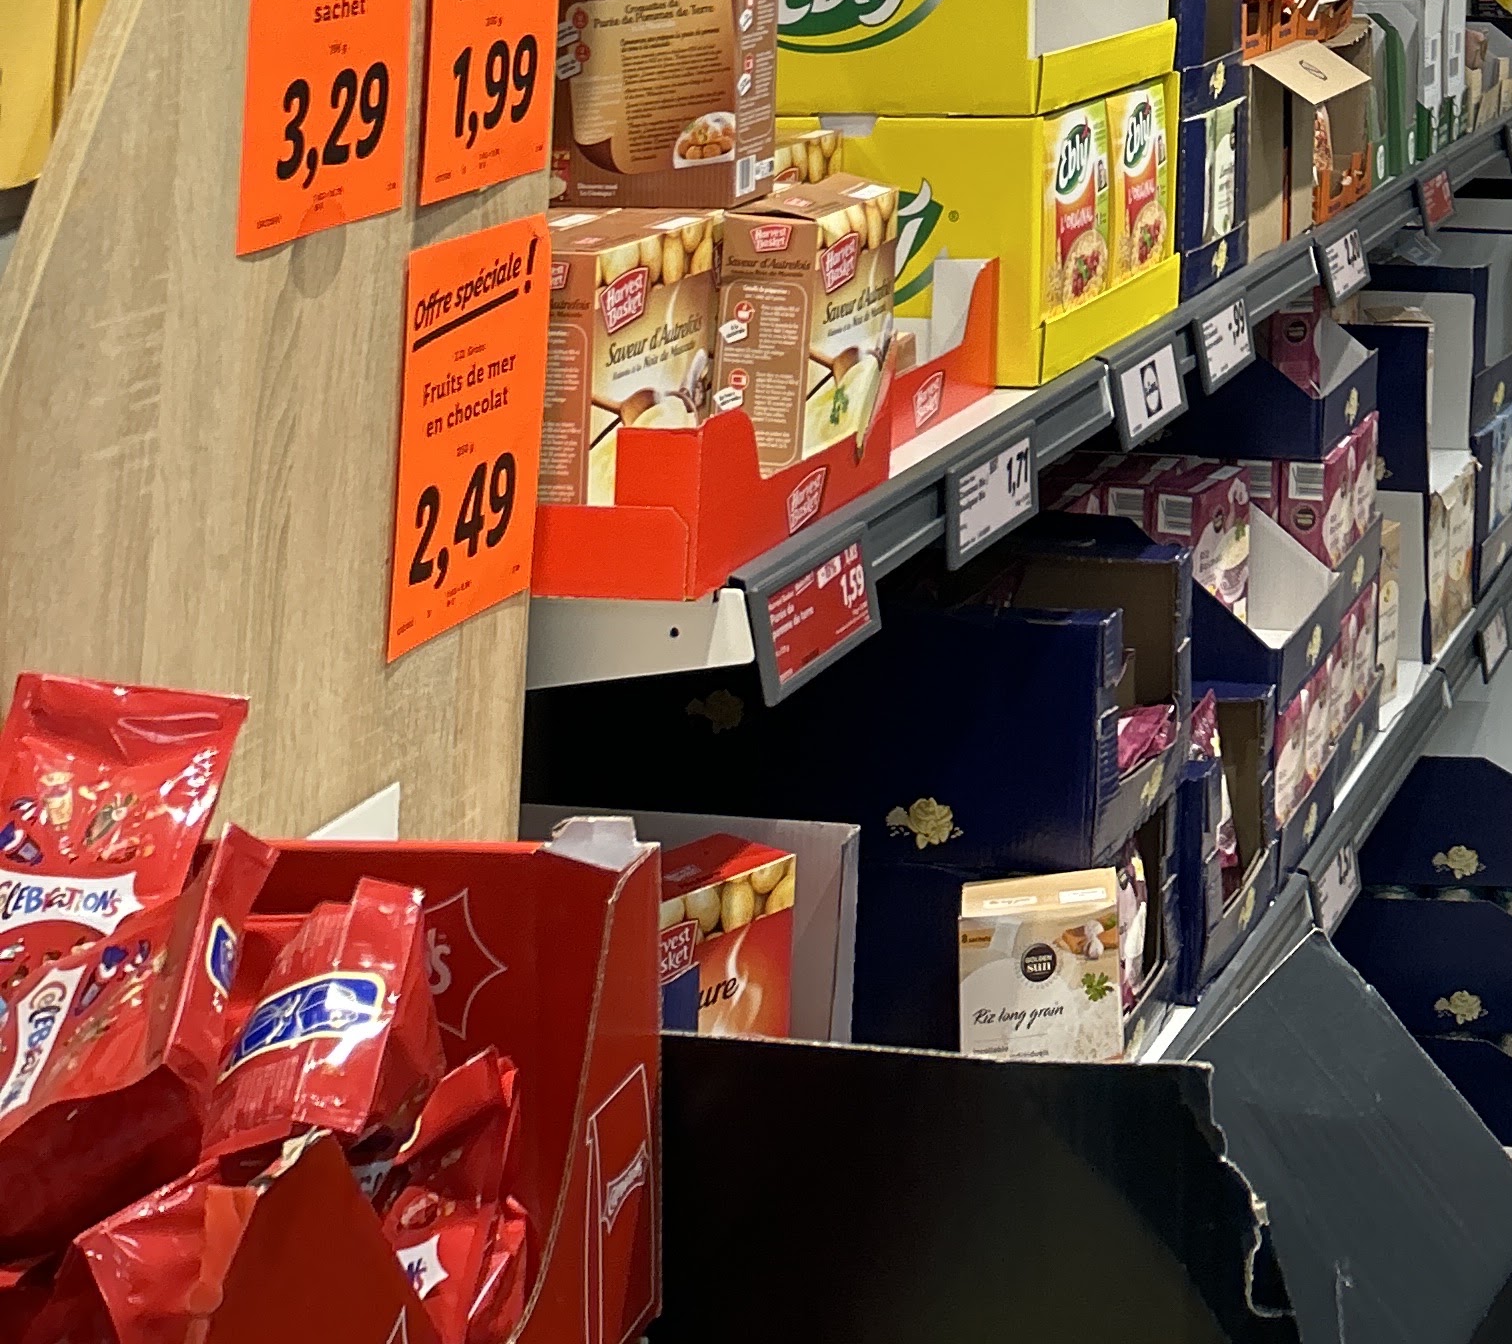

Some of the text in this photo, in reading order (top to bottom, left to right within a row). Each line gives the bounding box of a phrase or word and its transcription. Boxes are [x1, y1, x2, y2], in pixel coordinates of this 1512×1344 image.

[453, 33, 539, 151] 1,99
[275, 60, 390, 190] 3,29
[825, 239, 856, 267] Harvest
[414, 237, 539, 332] Offre spéciale !
[826, 257, 855, 288] Basket
[606, 273, 644, 310] Harvest
[607, 291, 643, 329] Basket
[823, 297, 859, 325] Saveur
[605, 337, 648, 368] Saveur
[422, 355, 517, 407] Fruits de mer
[425, 386, 509, 438] en chocolat
[408, 452, 519, 591] 2,49
[839, 563, 865, 609] 1,59
[659, 945, 690, 972] sket
[700, 975, 738, 1011] ure
[972, 1000, 1065, 1031] Riz long grain
